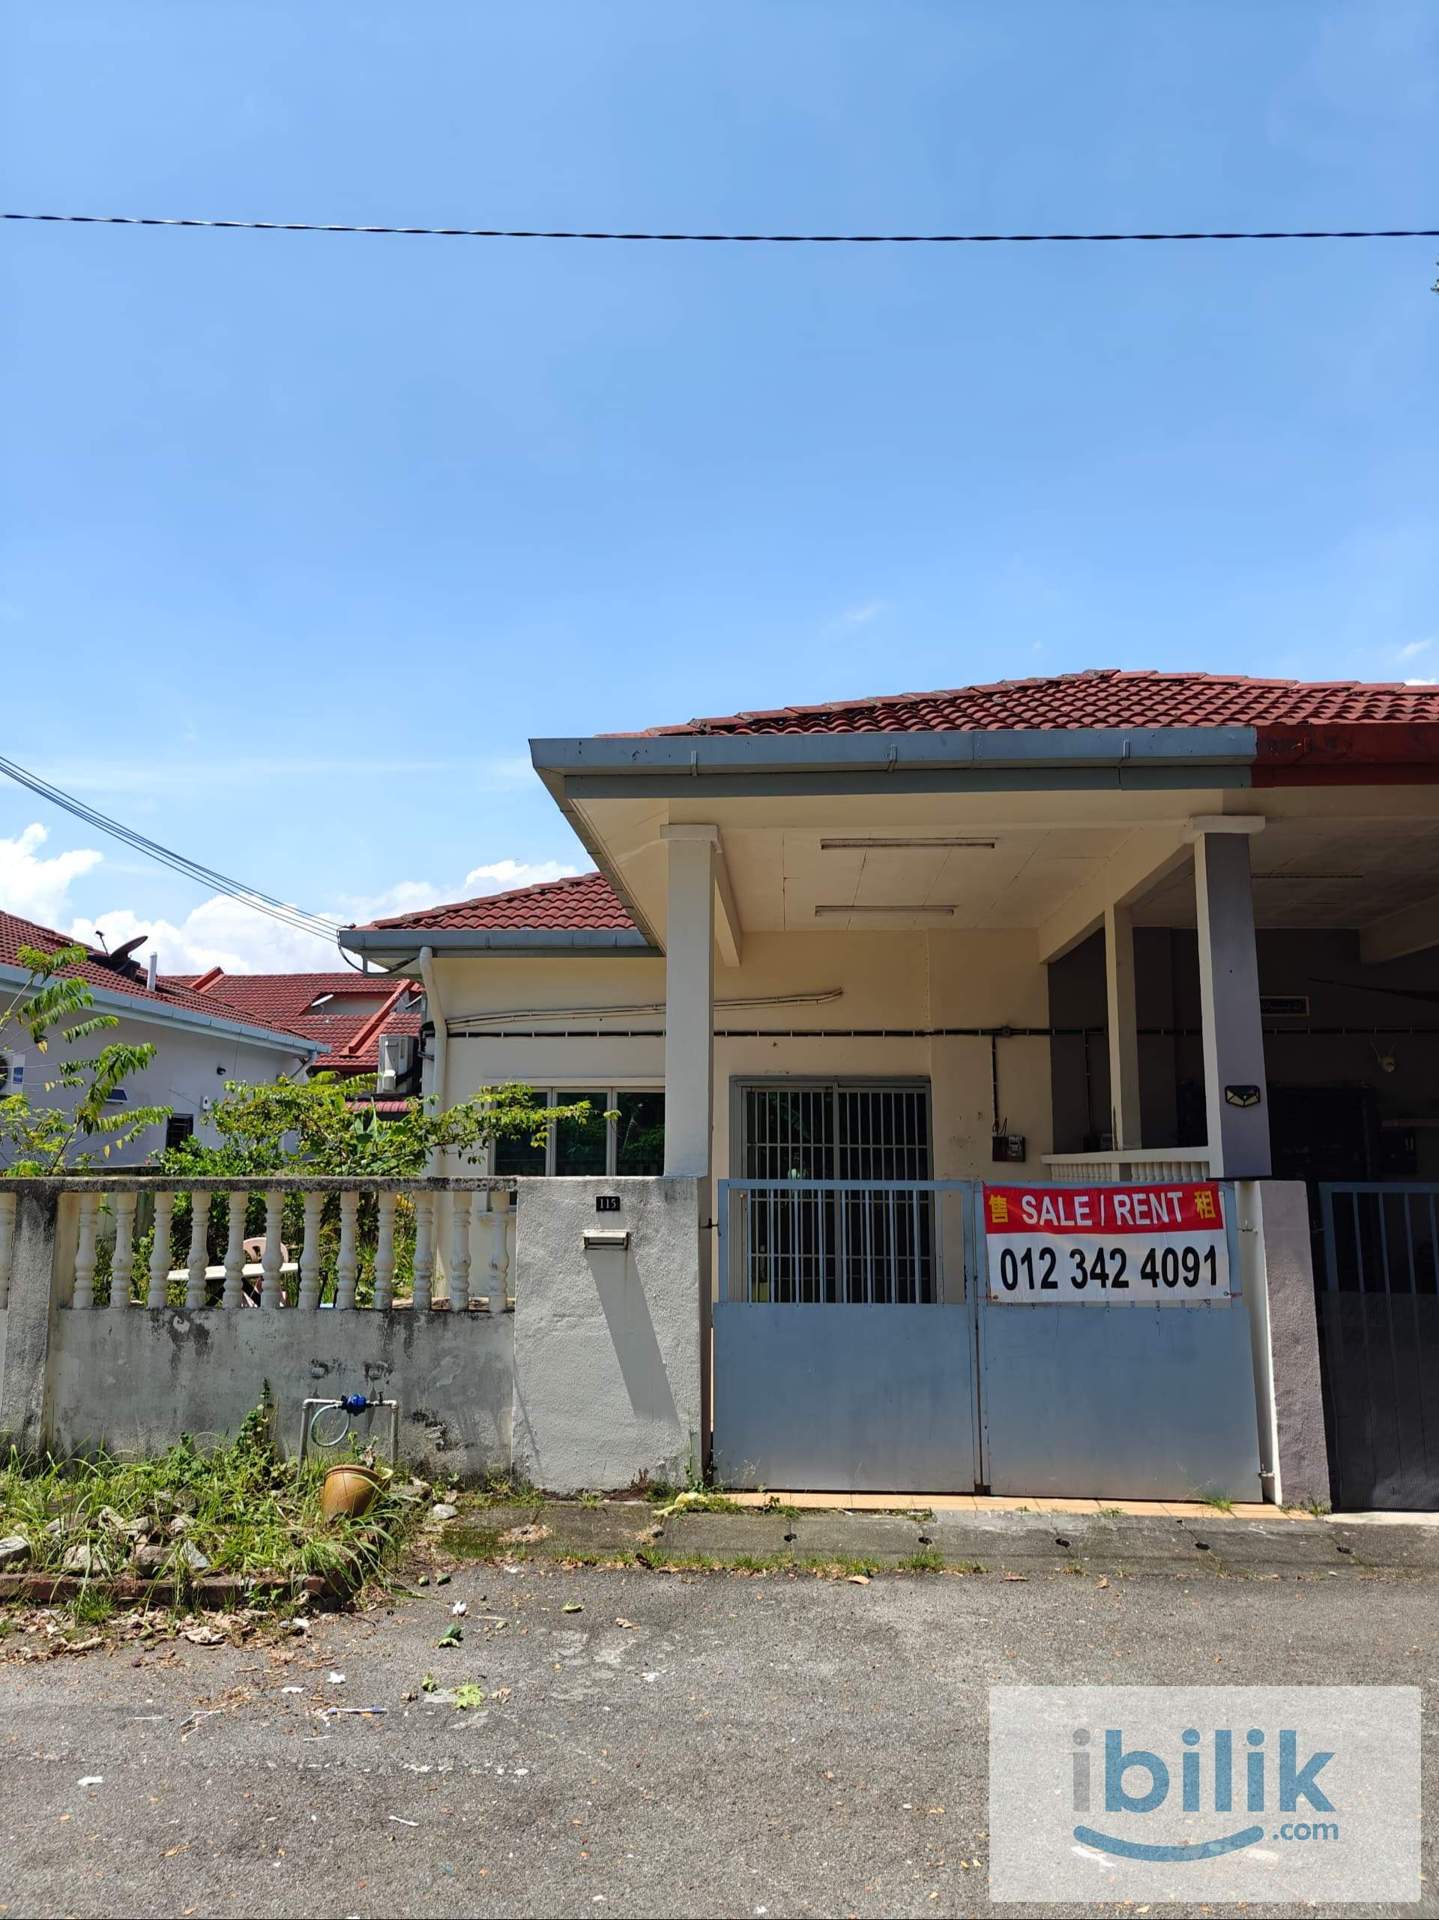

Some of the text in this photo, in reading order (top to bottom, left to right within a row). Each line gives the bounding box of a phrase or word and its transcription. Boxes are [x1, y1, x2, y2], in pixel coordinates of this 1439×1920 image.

[600, 1198, 616, 1209] 115
[989, 1195, 1008, 1223] 售
[1021, 1195, 1092, 1226] SALE
[1113, 1191, 1183, 1226] RENT
[1194, 1190, 1216, 1219] 租
[1000, 1244, 1217, 1291] 012 342 4091
